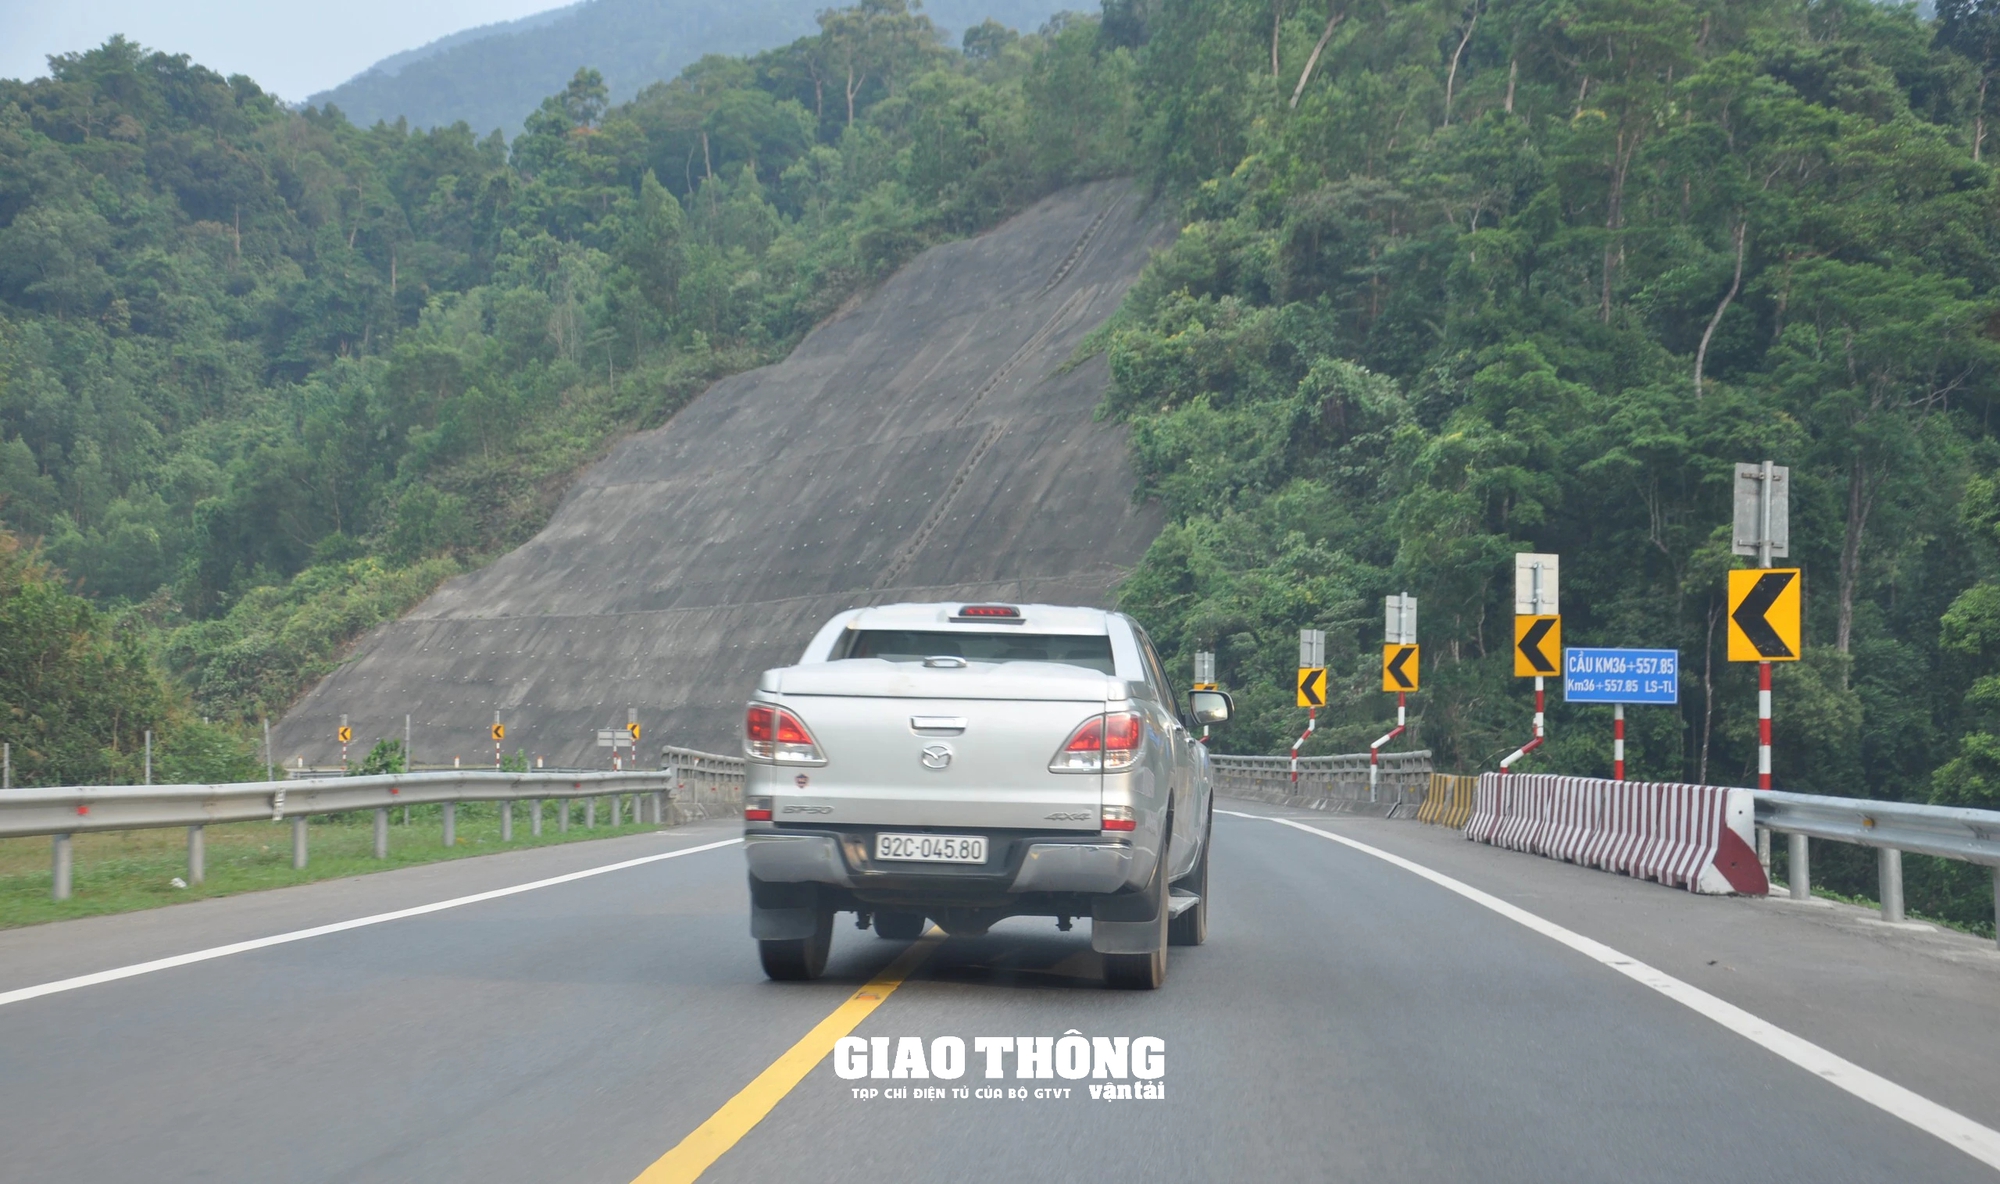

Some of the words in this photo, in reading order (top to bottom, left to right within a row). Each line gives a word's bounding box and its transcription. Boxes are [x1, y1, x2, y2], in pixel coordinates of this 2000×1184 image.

[1595, 657, 1674, 674] KM36+557.85
[1567, 679, 1638, 692] Km36+557.85
[1645, 680, 1675, 693] LS-TL
[881, 837, 982, 860] 92C-045.80
